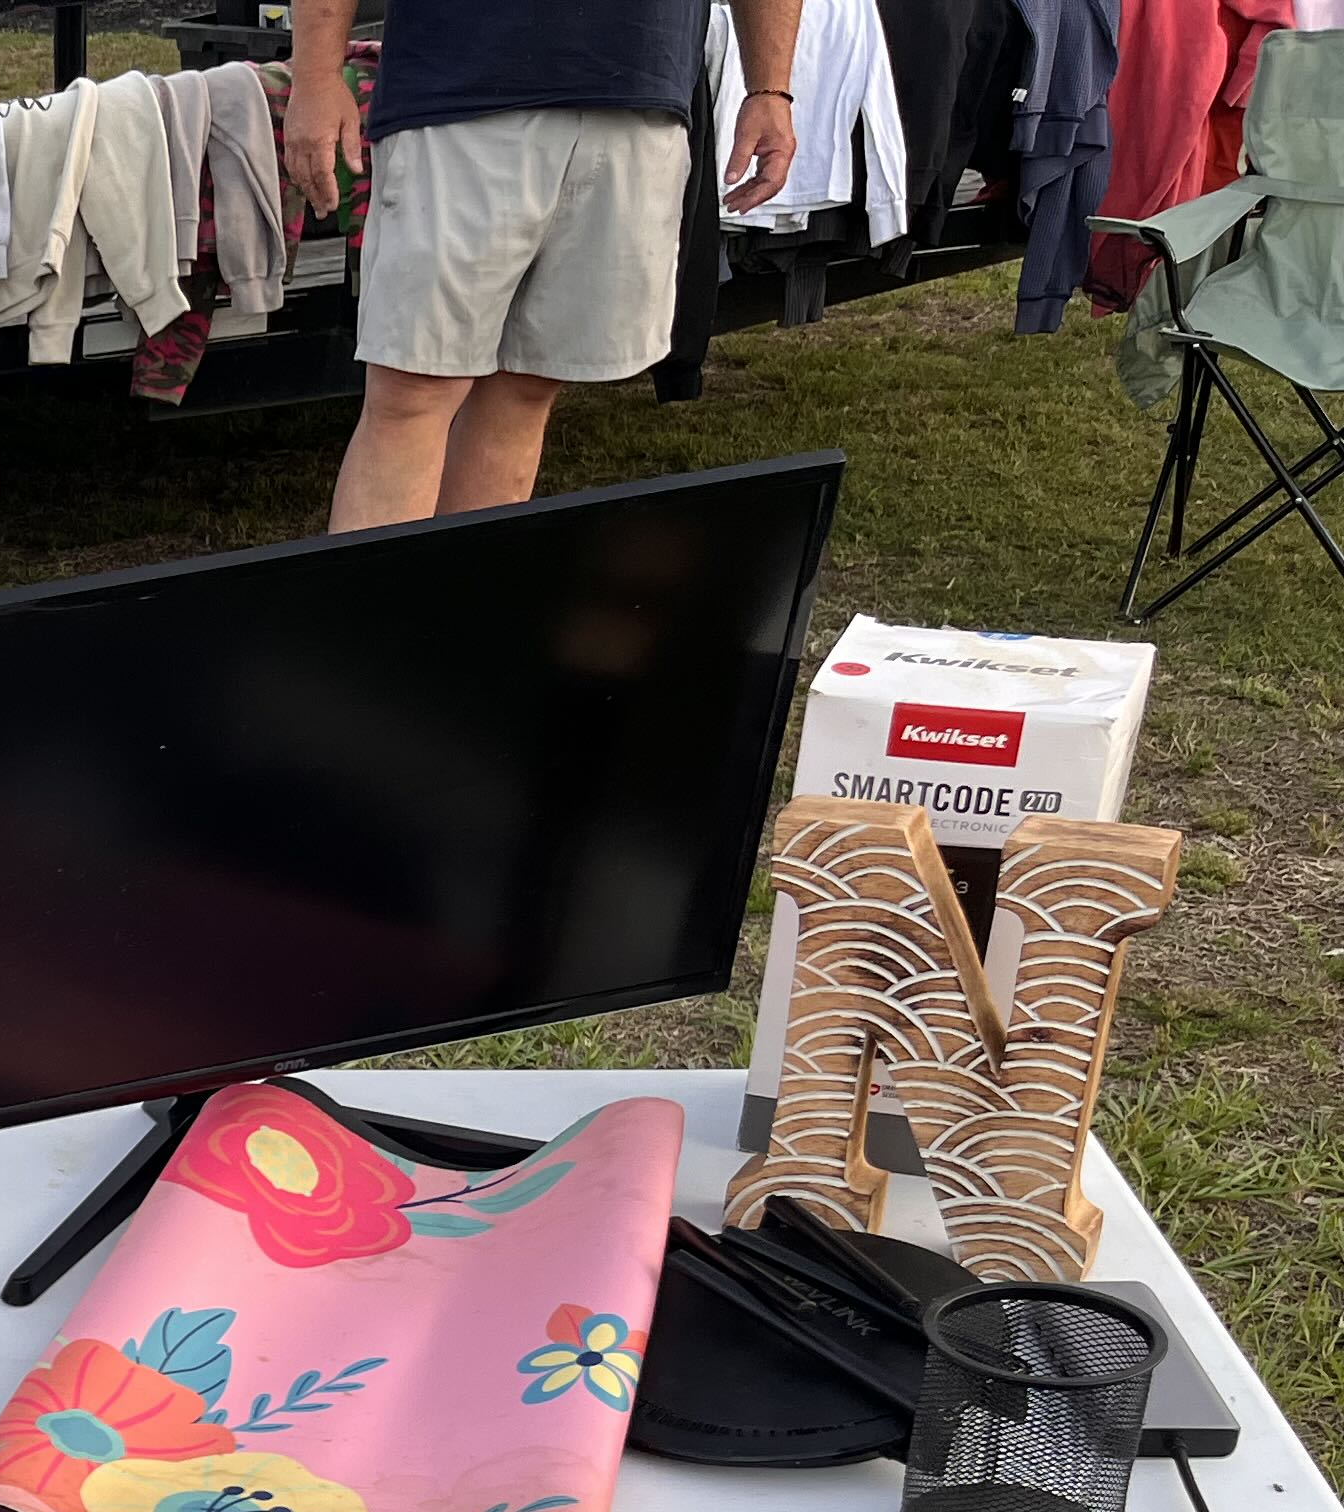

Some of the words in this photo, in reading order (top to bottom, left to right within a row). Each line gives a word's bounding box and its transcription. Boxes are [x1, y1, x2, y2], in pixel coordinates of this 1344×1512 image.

[883, 652, 1082, 679] Kwikset
[901, 724, 1008, 750] Kwikset
[831, 771, 1015, 818] SMARTCODE
[1023, 793, 1059, 812] 270
[930, 817, 1010, 835] ECTRONIC
